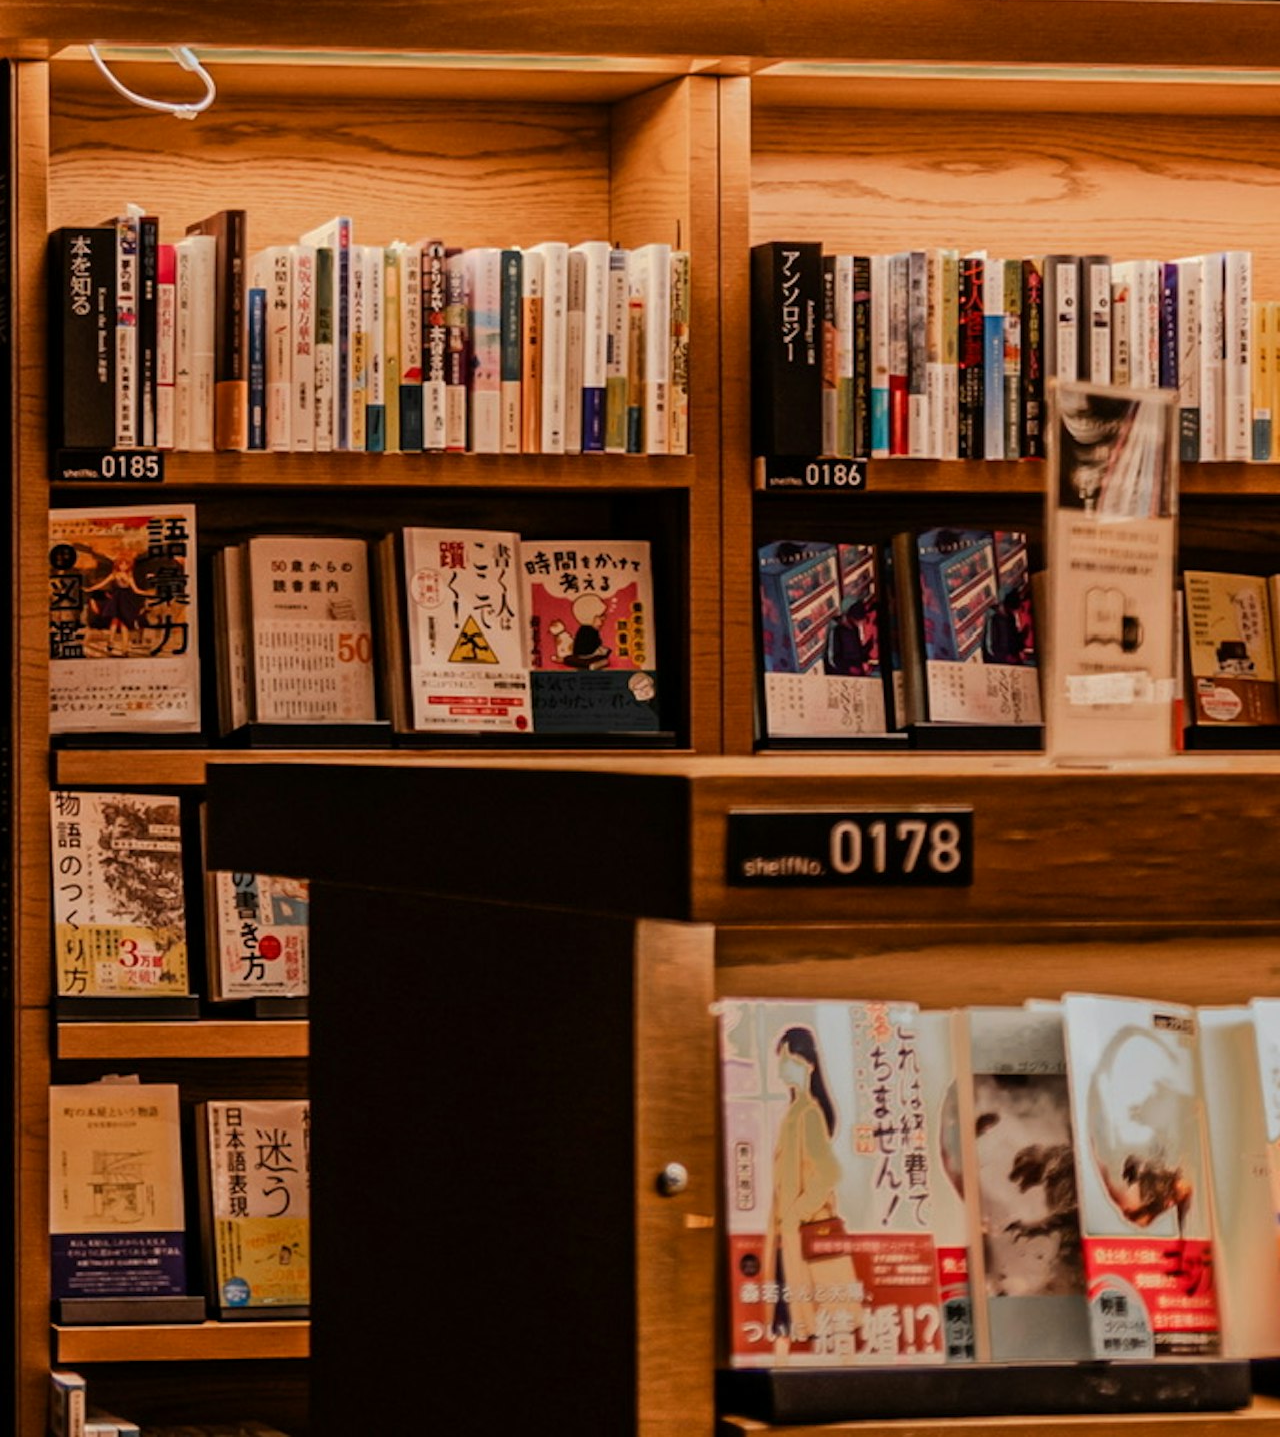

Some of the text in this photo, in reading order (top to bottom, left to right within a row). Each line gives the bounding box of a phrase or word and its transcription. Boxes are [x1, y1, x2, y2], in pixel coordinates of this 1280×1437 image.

[70, 236, 91, 315] 本を知る
[781, 251, 801, 362] アンソロジー
[101, 455, 159, 478] 0185
[805, 464, 862, 486] 0186
[147, 518, 191, 656] 語彙力
[271, 560, 353, 573] 50歳からの
[273, 580, 339, 593] 読書案内
[473, 541, 495, 629] ここで
[525, 551, 641, 575] 時間をかけて
[559, 573, 610, 593] 考える
[338, 633, 372, 663] 50
[743, 818, 962, 877] shelfNo. 0178
[55, 791, 89, 994] 物語のつくり方
[225, 1107, 249, 1218] 日本語表現
[255, 1128, 299, 1218] 迷う
